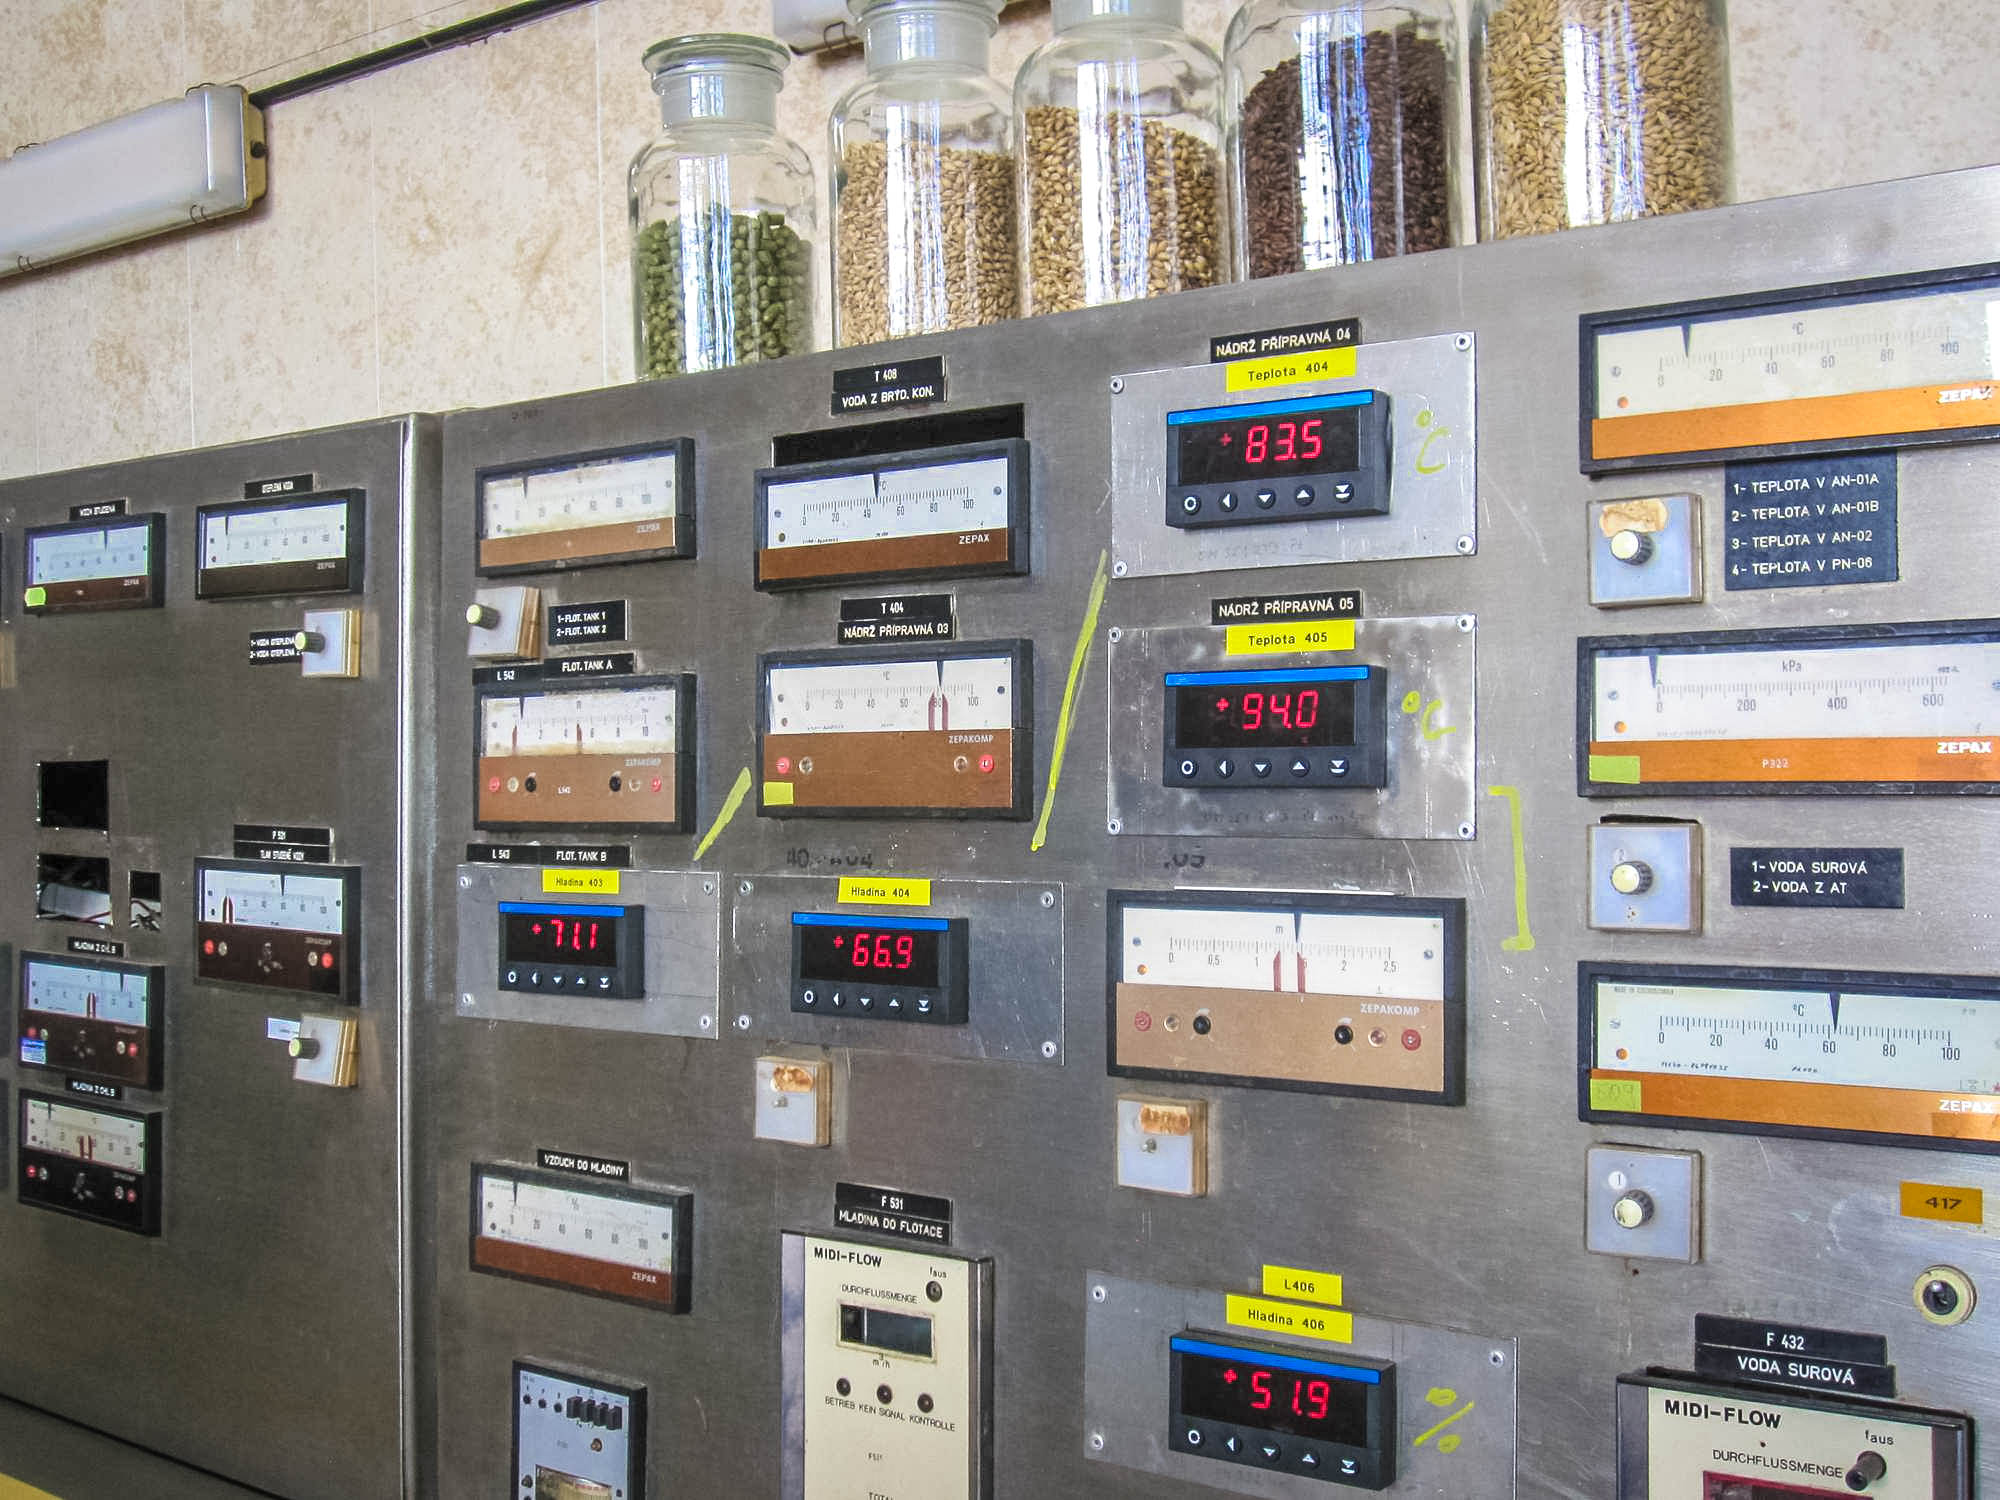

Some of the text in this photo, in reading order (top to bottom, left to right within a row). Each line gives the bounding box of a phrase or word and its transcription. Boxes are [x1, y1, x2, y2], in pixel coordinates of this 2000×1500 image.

[1261, 328, 1331, 351] PŘÍPRAVNÁ
[1336, 327, 1351, 341] 04
[1248, 361, 1328, 381] Teplota 404
[1657, 341, 1960, 387] 0 20 40 60 80 100
[874, 368, 898, 382] T 408
[842, 394, 867, 408] VODA
[870, 393, 878, 404] Z
[912, 385, 935, 399] KON.
[1752, 479, 1810, 494] TEPLOTA
[1816, 477, 1825, 489] V
[1832, 474, 1879, 487] AN-01A
[831, 512, 840, 523] 20
[962, 499, 974, 510] 100
[1752, 505, 1810, 521] TEPLOTA
[1816, 504, 1826, 515] V
[1832, 500, 1879, 514] AN-01B
[959, 534, 991, 545] ZEPAX
[1752, 534, 1811, 548] TEPLOTA
[1816, 532, 1826, 543] V
[1832, 530, 1872, 543] AN-02
[1752, 560, 1811, 575] TEPLOTA
[1816, 559, 1826, 570] V
[1832, 556, 1873, 569] PN-06
[881, 602, 904, 614] T 404
[1219, 597, 1354, 617] NÁDRŽ PŘÍPRAVNÁ 05
[583, 612, 600, 622] TANK
[601, 611, 606, 620] 1
[583, 625, 600, 635] TANK
[601, 624, 607, 634] 2
[880, 622, 933, 637] PŘÍPRAVNÁ
[937, 623, 949, 634] 03
[1248, 632, 1328, 647] Teplota 405
[561, 661, 583, 672] FLOT.
[584, 660, 604, 671] TANK
[605, 659, 613, 670] A
[1781, 659, 1803, 672] kPa
[866, 698, 875, 709] 40
[967, 695, 979, 707] 100
[1656, 693, 1944, 713] 0 200 400 600
[948, 734, 994, 744] ZEPAKOMP
[1937, 741, 1992, 754] ZEPAX
[556, 850, 577, 861] FLOT.
[578, 851, 598, 861] TANK
[600, 851, 607, 862] B
[1769, 860, 1805, 874] VODA
[1811, 859, 1868, 875] SUROVÁ
[556, 877, 604, 888] Hladina 403
[1771, 881, 1809, 894] VODA
[1814, 881, 1824, 894] Z
[1830, 882, 1848, 895] AT
[851, 886, 911, 898] Hladina 404
[1275, 925, 1284, 935] m
[1168, 952, 1174, 963] 0
[1207, 953, 1220, 967] 0,5
[1341, 960, 1347, 972] 2
[1383, 960, 1398, 974] 2,5
[1360, 1002, 1420, 1017] ZEPAKOMP
[1658, 1031, 1960, 1061] 0 20 40 60 80 100
[1939, 1099, 1993, 1113] ZEPAX
[544, 1153, 624, 1176] VZDUCH DO MLADINY
[881, 1195, 904, 1210] F 531
[1925, 1196, 1962, 1210] 417
[839, 1209, 944, 1239] MLADINA DO FLOTACE
[814, 1246, 882, 1268] MIDI-FLOW
[841, 1283, 919, 1304] DURCHFLUSSMENGE
[1284, 1278, 1315, 1294] L406
[1247, 1308, 1326, 1332] Hladina 406
[1766, 1332, 1805, 1350] F 432
[1737, 1355, 1855, 1385] VODA SUROVÁ
[825, 1395, 956, 1432] BETRIEB KEIN SIGNAL KONTROLLE
[1413, 1387, 1475, 1454] %
[1664, 1399, 1782, 1430] MIDI-FLOW
[1713, 1449, 1843, 1478] DURCHFLUSSMENGE
